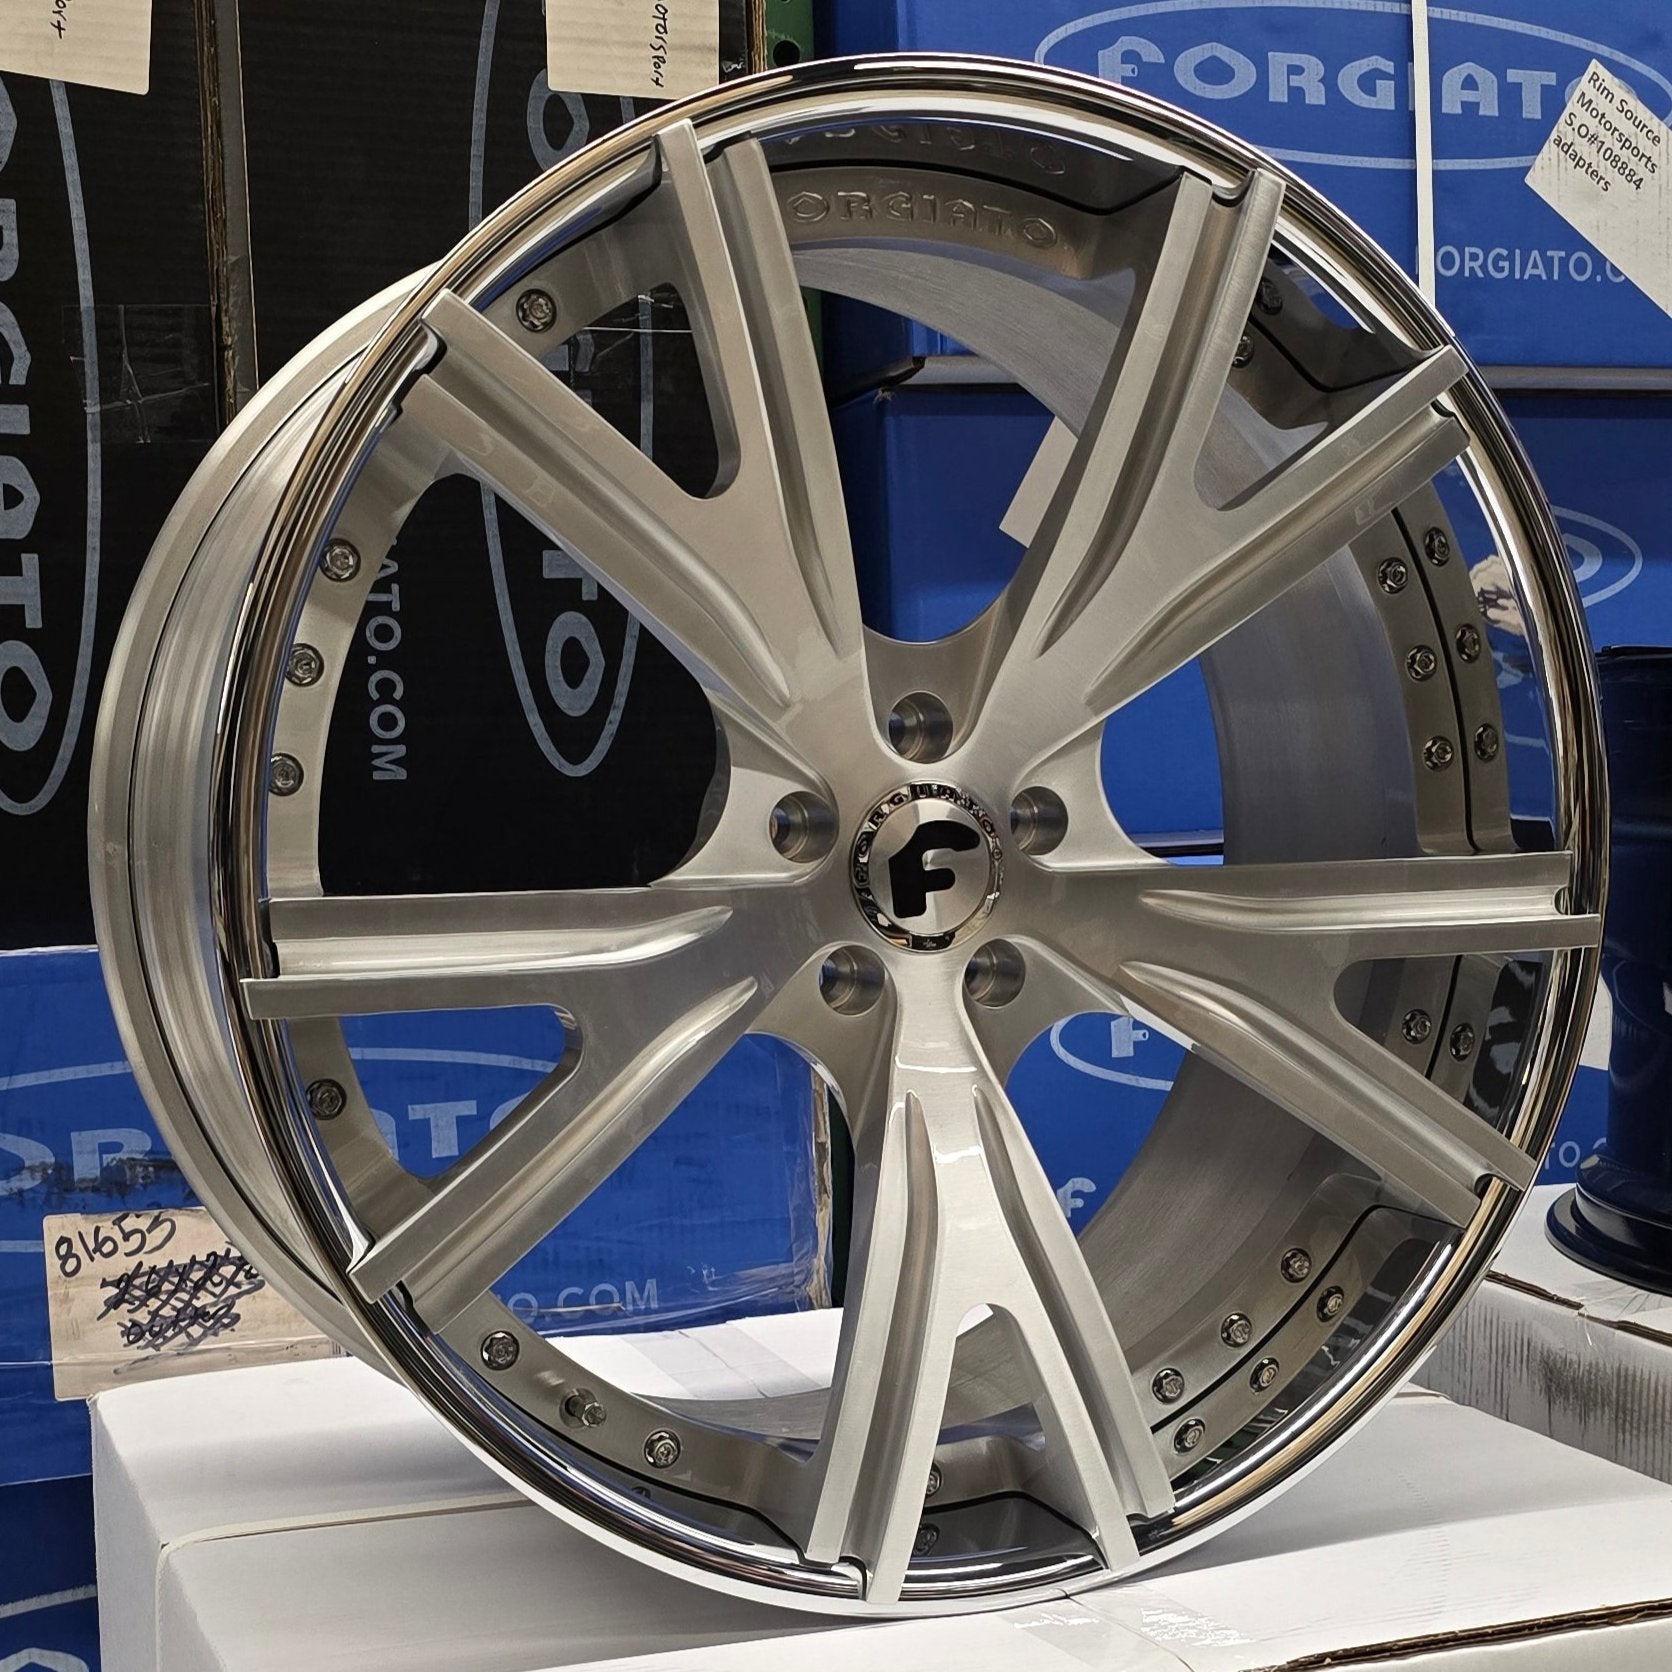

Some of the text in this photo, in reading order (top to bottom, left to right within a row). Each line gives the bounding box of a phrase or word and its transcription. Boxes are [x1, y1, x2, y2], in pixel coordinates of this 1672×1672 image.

[649, 0, 669, 88] otorsport
[1097, 36, 1638, 120] FORGAT
[1576, 91, 1658, 174] Motorsports
[1588, 71, 1661, 147] Rim Source
[1552, 134, 1611, 192] adapters
[1564, 112, 1644, 190] S.O#108884
[1416, 245, 1627, 284] ORGIATO.C
[366, 538, 408, 781] ATO.COM
